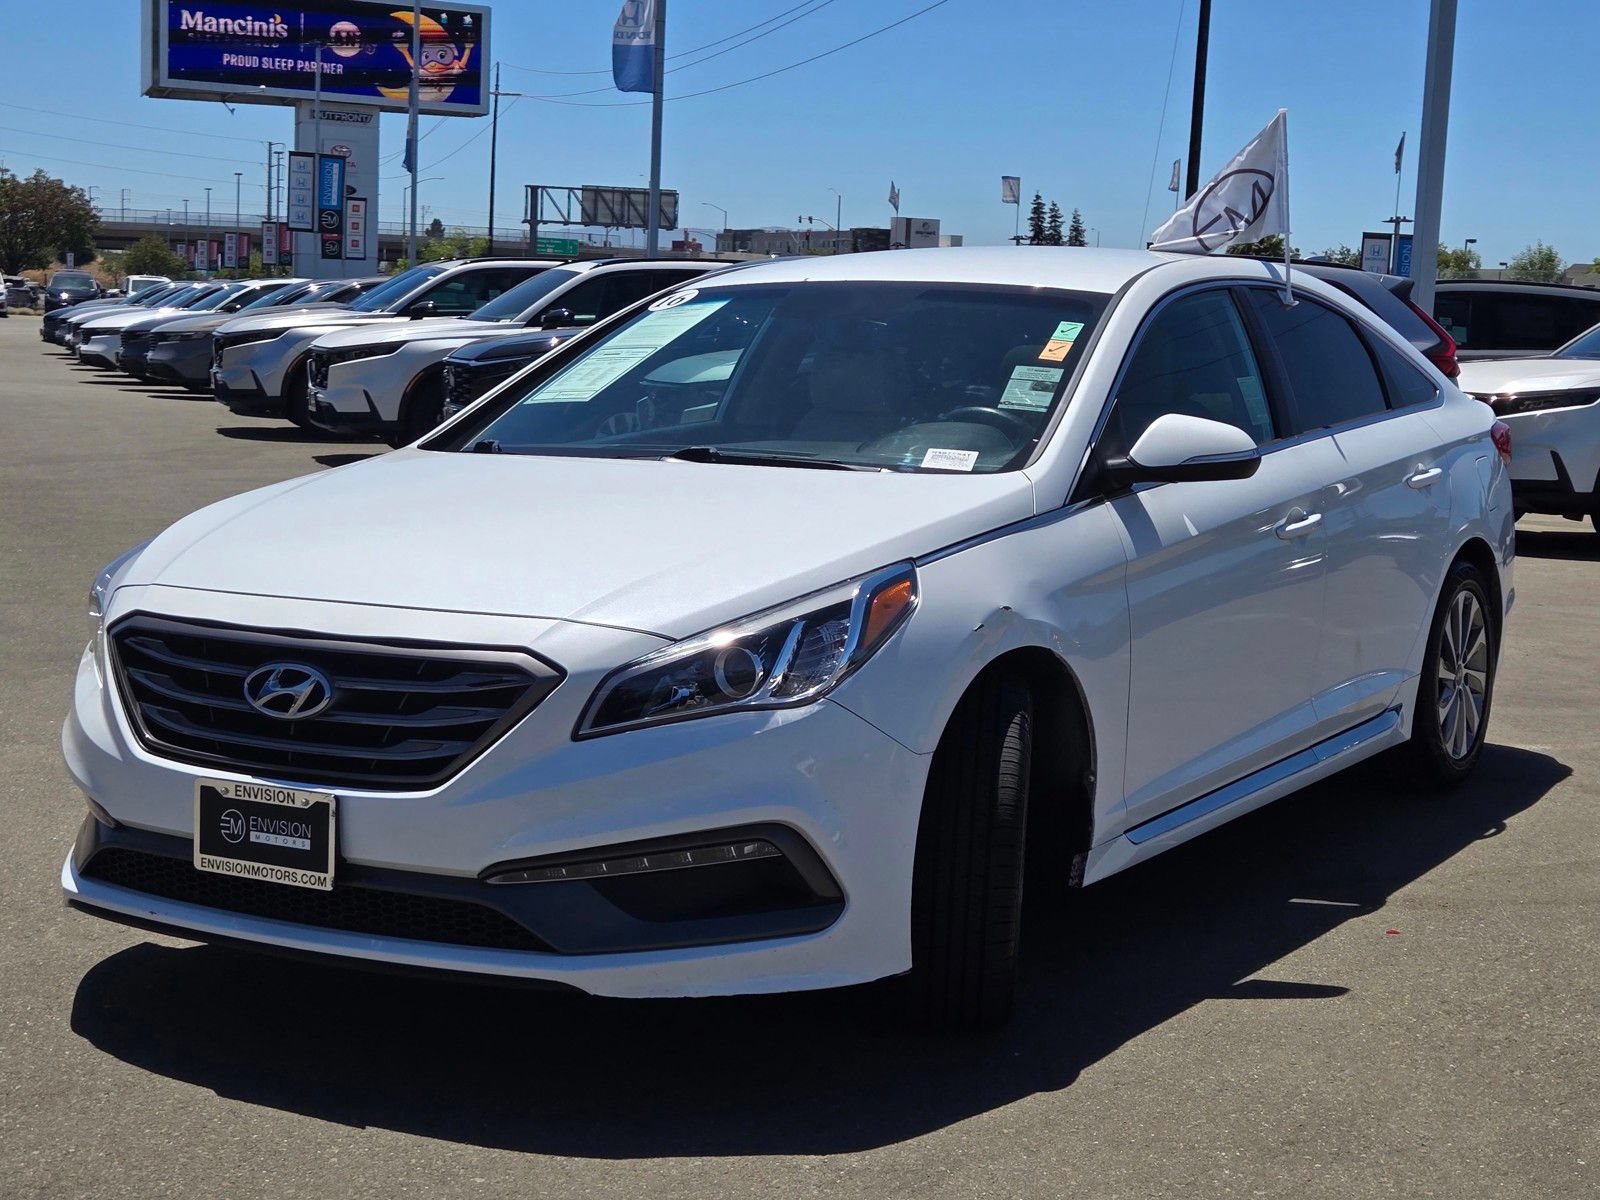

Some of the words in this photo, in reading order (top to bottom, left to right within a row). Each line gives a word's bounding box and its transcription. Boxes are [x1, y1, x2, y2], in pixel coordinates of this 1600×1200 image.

[222, 53, 259, 68] PROUD
[262, 57, 294, 70] SLEEP
[297, 60, 344, 75] PARTNER
[323, 162, 334, 206] ENVISION
[1401, 244, 1412, 276] ISION
[234, 785, 296, 805] ENVISION
[249, 816, 312, 838] ENVISION
[255, 834, 306, 848] MOTORS
[200, 857, 327, 888] ENVISIONMOTORS.COM
